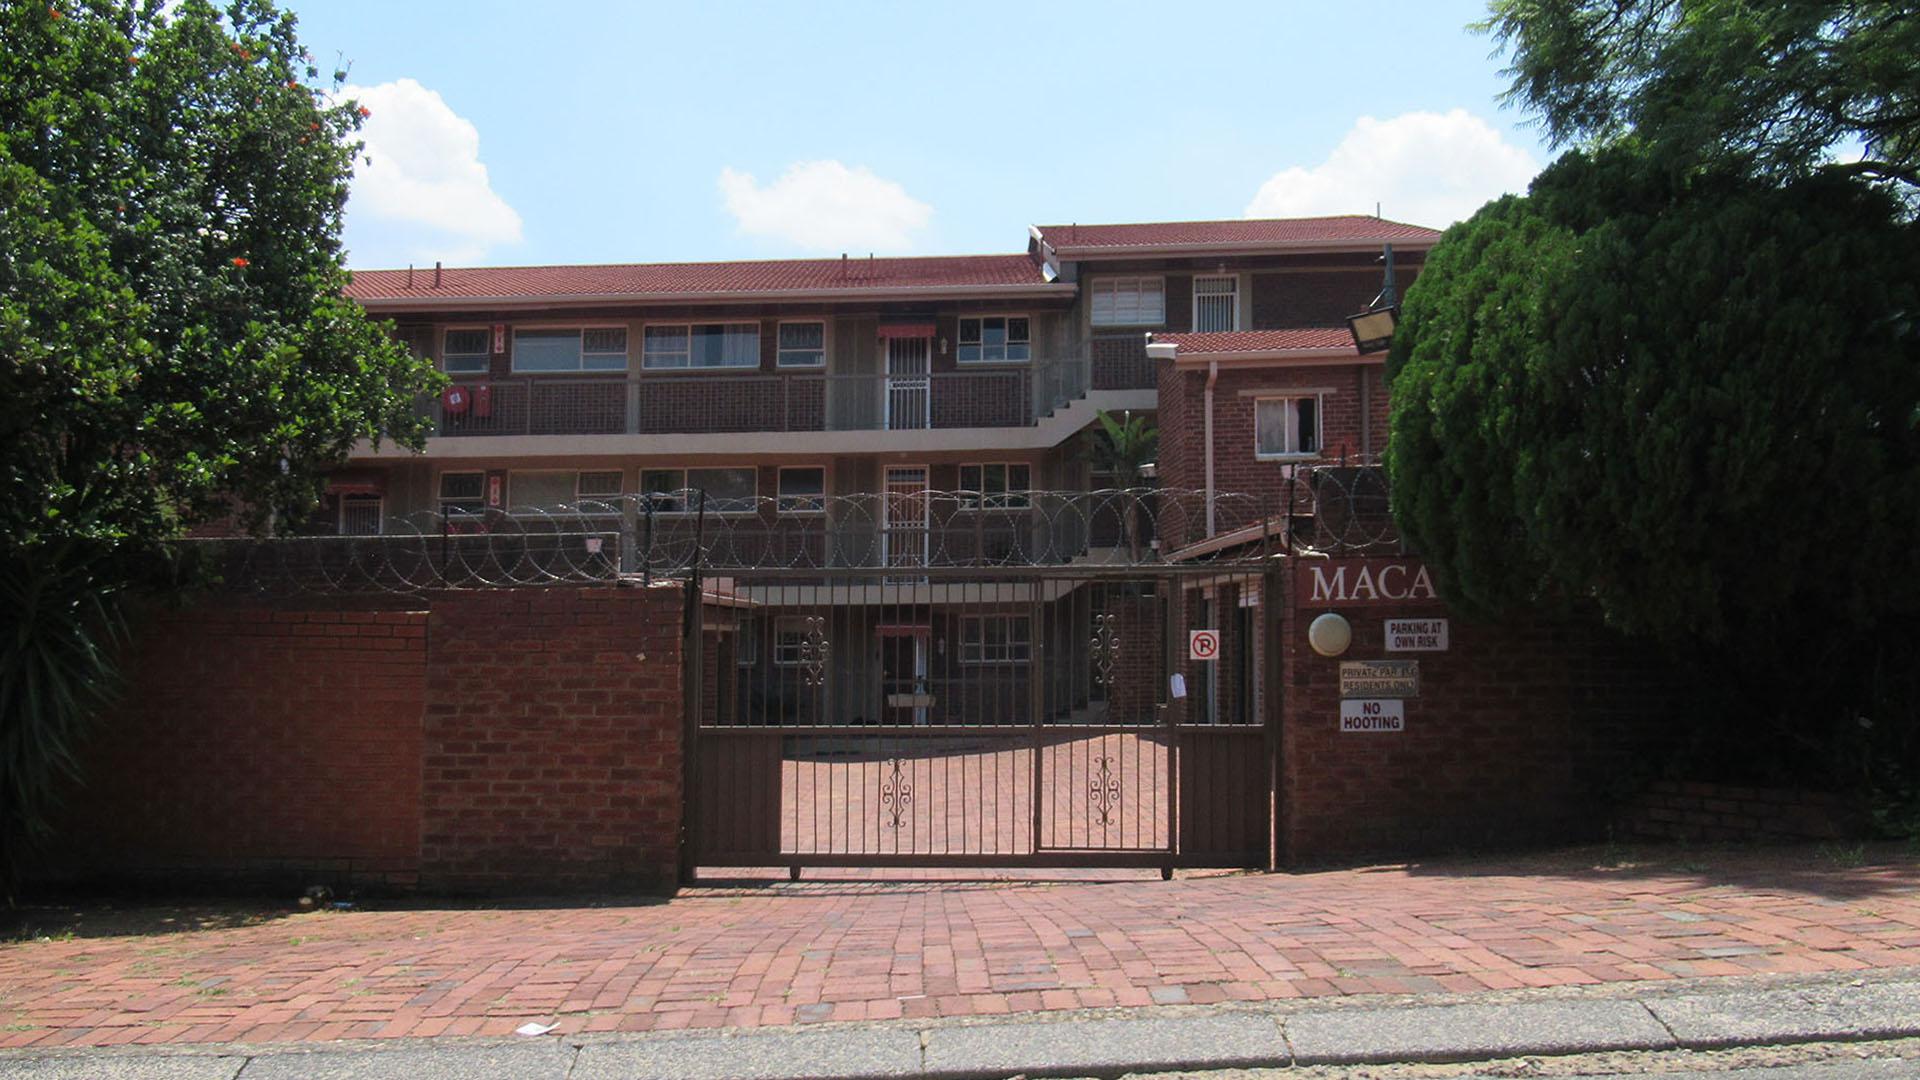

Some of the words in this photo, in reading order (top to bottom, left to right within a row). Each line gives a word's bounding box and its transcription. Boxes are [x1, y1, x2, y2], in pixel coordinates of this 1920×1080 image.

[1310, 564, 1437, 600] MACA
[1390, 622, 1428, 634] PARKING
[1430, 621, 1442, 633] AT
[1394, 636, 1415, 648] OWN
[1417, 636, 1438, 647] RISK
[1343, 681, 1391, 690] RESIDENTS
[1363, 702, 1380, 714] NO
[1344, 717, 1400, 729] HOOTING
